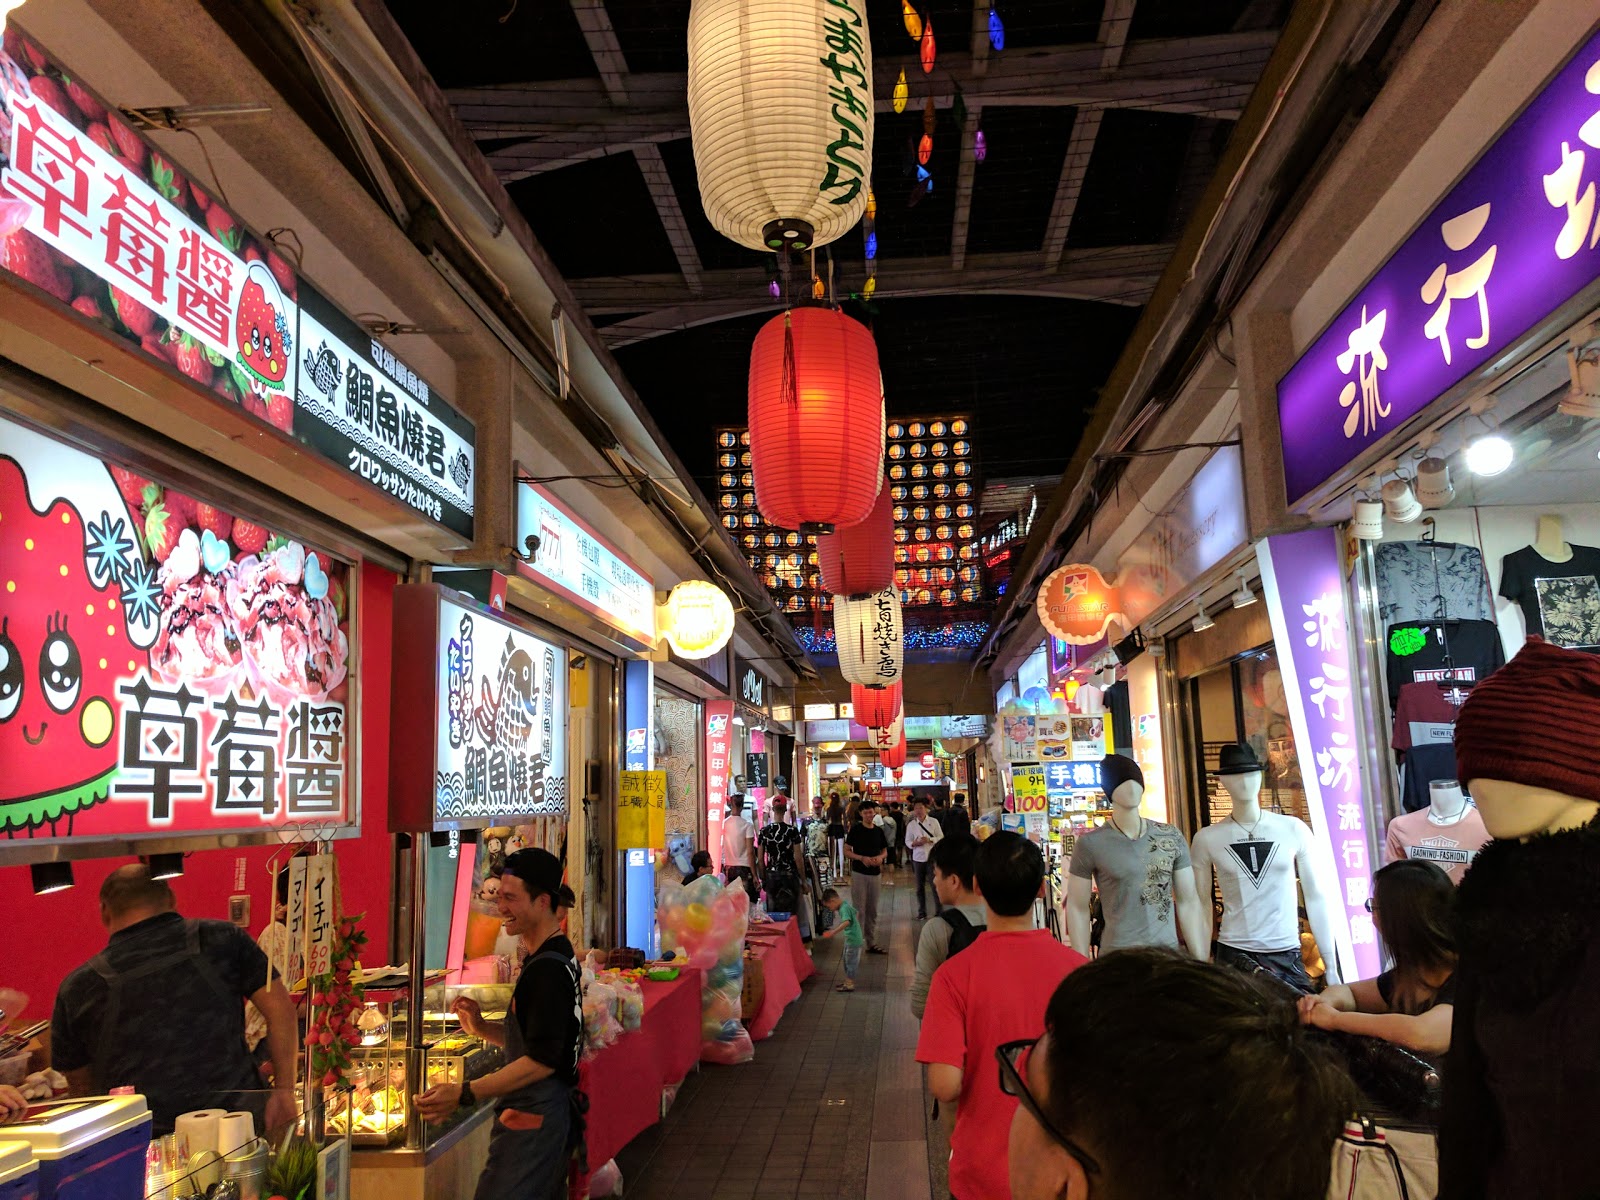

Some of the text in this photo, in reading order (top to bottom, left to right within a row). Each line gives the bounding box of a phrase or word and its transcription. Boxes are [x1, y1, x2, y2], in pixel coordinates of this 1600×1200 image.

[5, 101, 234, 349] 草莓醬
[346, 358, 447, 480] 鯛魚燒君
[348, 447, 443, 522] クロワッサンたいやき
[448, 640, 461, 748] たいやき
[460, 614, 473, 743] クロワッサン
[1303, 594, 1355, 793] 流行坊
[114, 676, 344, 819] 草莓醬
[464, 746, 546, 806] 鯛魚燒君
[707, 742, 726, 821] 逢甲歡樂星
[1028, 776, 1045, 785] 9H
[621, 775, 665, 794] 誠徵
[1016, 795, 1046, 812] 100
[1424, 840, 1456, 848] MOTOR
[292, 880, 302, 953] マンゴー
[312, 877, 329, 943] イチゴ
[309, 960, 326, 975] 90
[311, 945, 328, 960] 60
